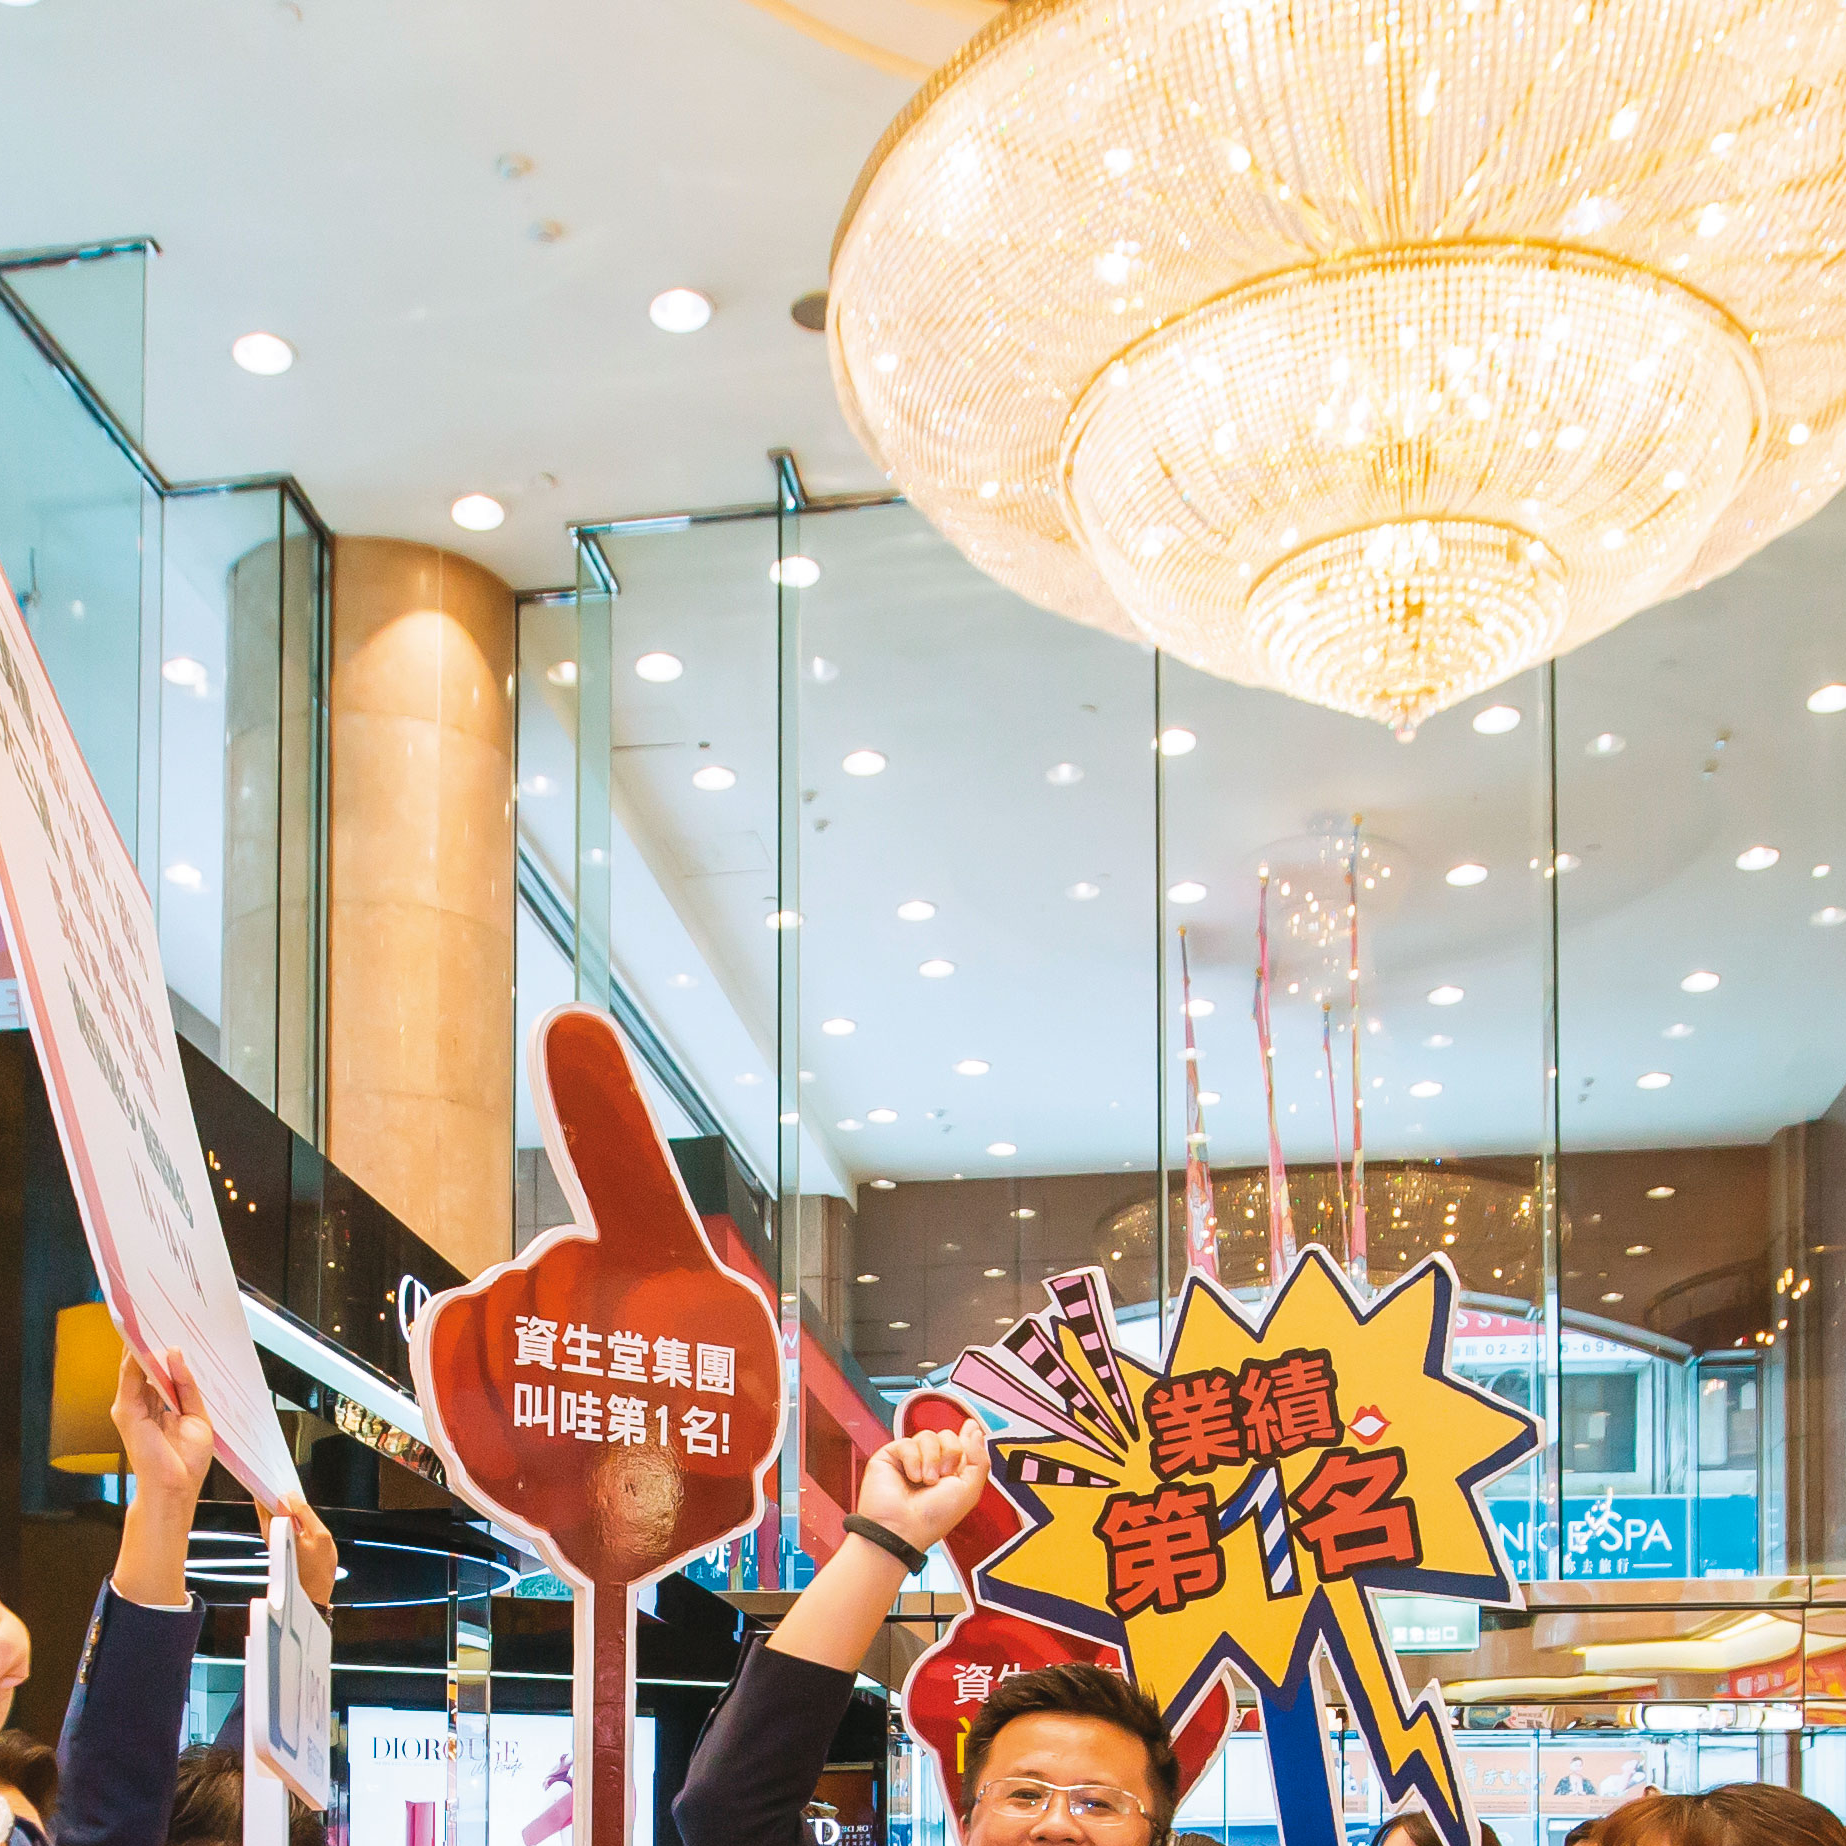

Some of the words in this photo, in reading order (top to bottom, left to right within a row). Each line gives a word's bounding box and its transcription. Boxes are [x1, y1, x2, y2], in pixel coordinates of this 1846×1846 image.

[513, 1314, 737, 1397] 資生堂集團
[512, 1383, 731, 1457] 叫哇第1名!
[1142, 1347, 1345, 1481] 業績
[1095, 1446, 1423, 1616] 第1名
